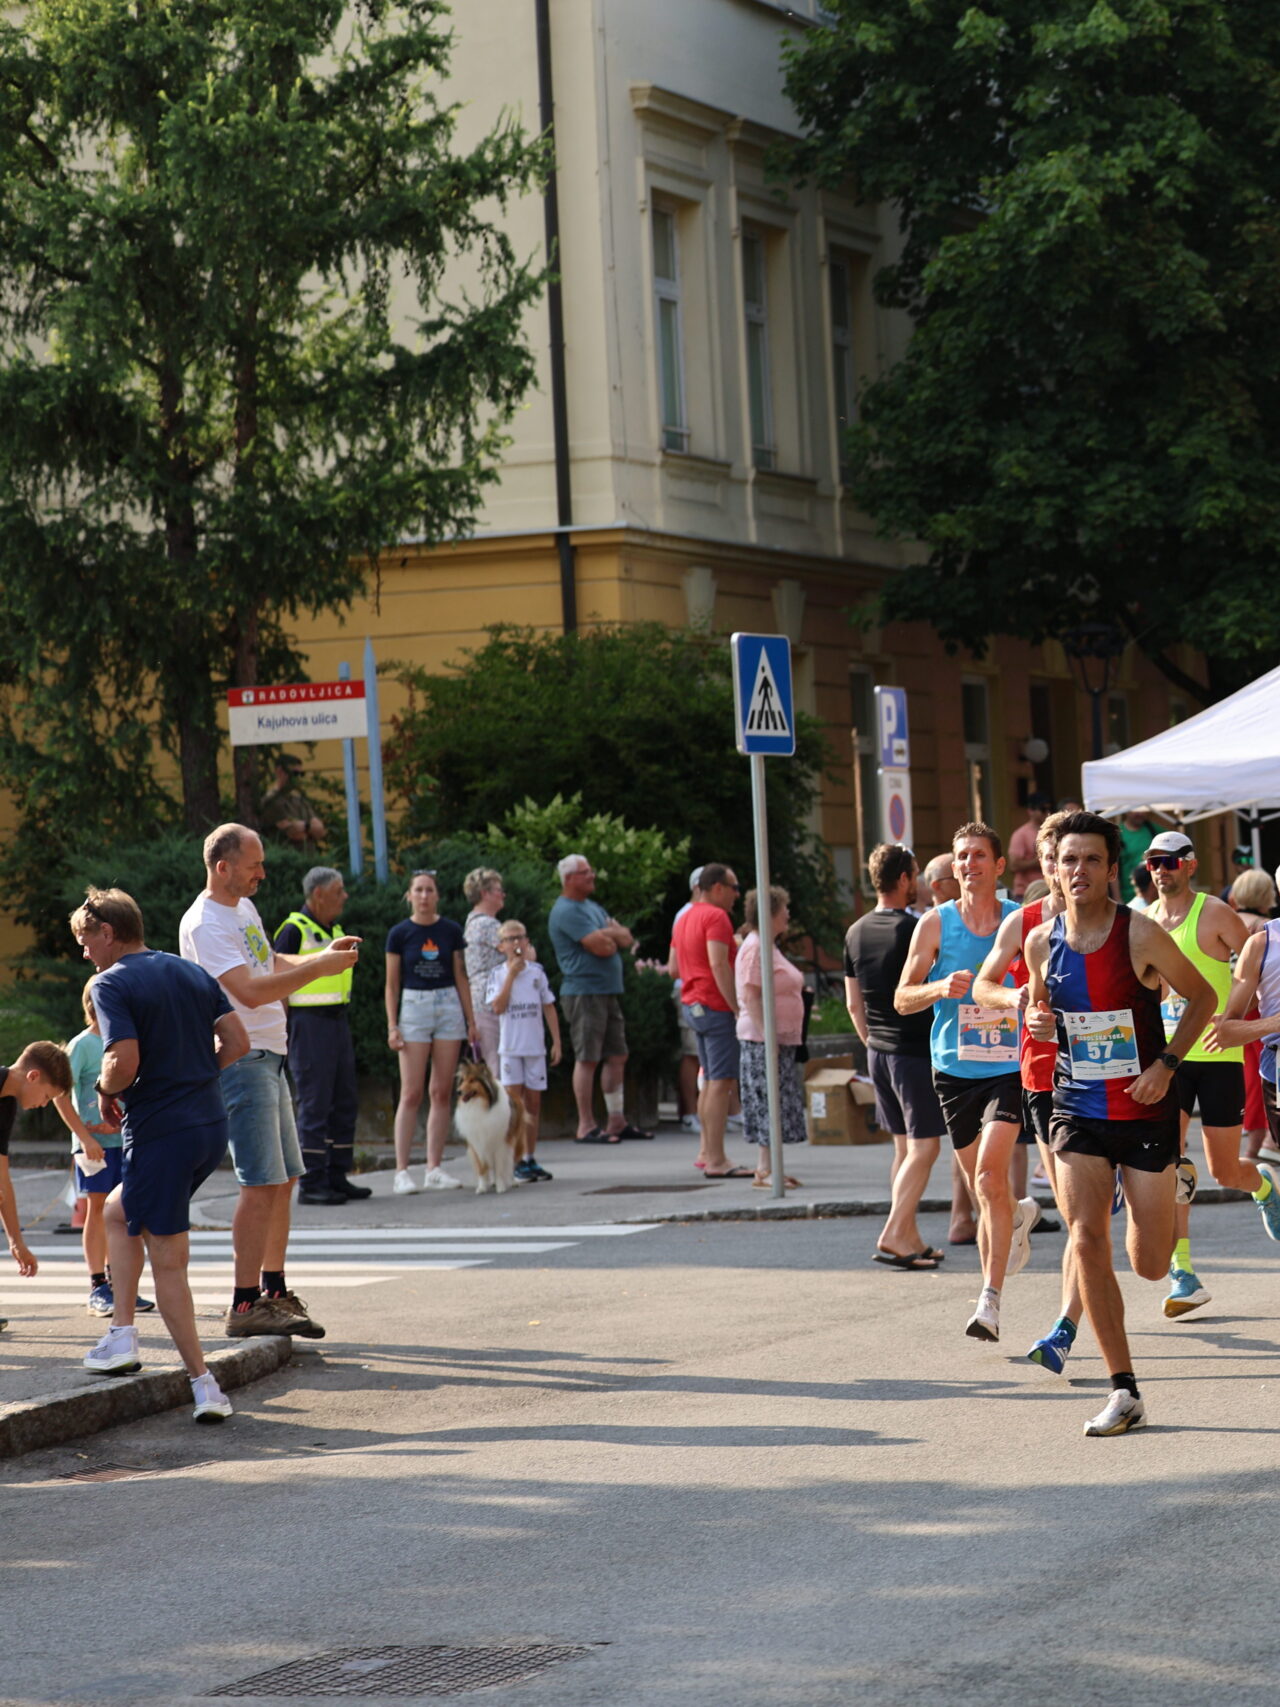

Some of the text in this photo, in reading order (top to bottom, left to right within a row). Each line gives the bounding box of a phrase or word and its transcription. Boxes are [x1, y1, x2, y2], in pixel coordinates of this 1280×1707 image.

[259, 685, 352, 701] RADOVLJICA
[257, 713, 338, 730] Kajuhova ulica
[880, 692, 897, 749] P
[978, 1029, 1002, 1045] 16
[1087, 1041, 1113, 1060] 57
